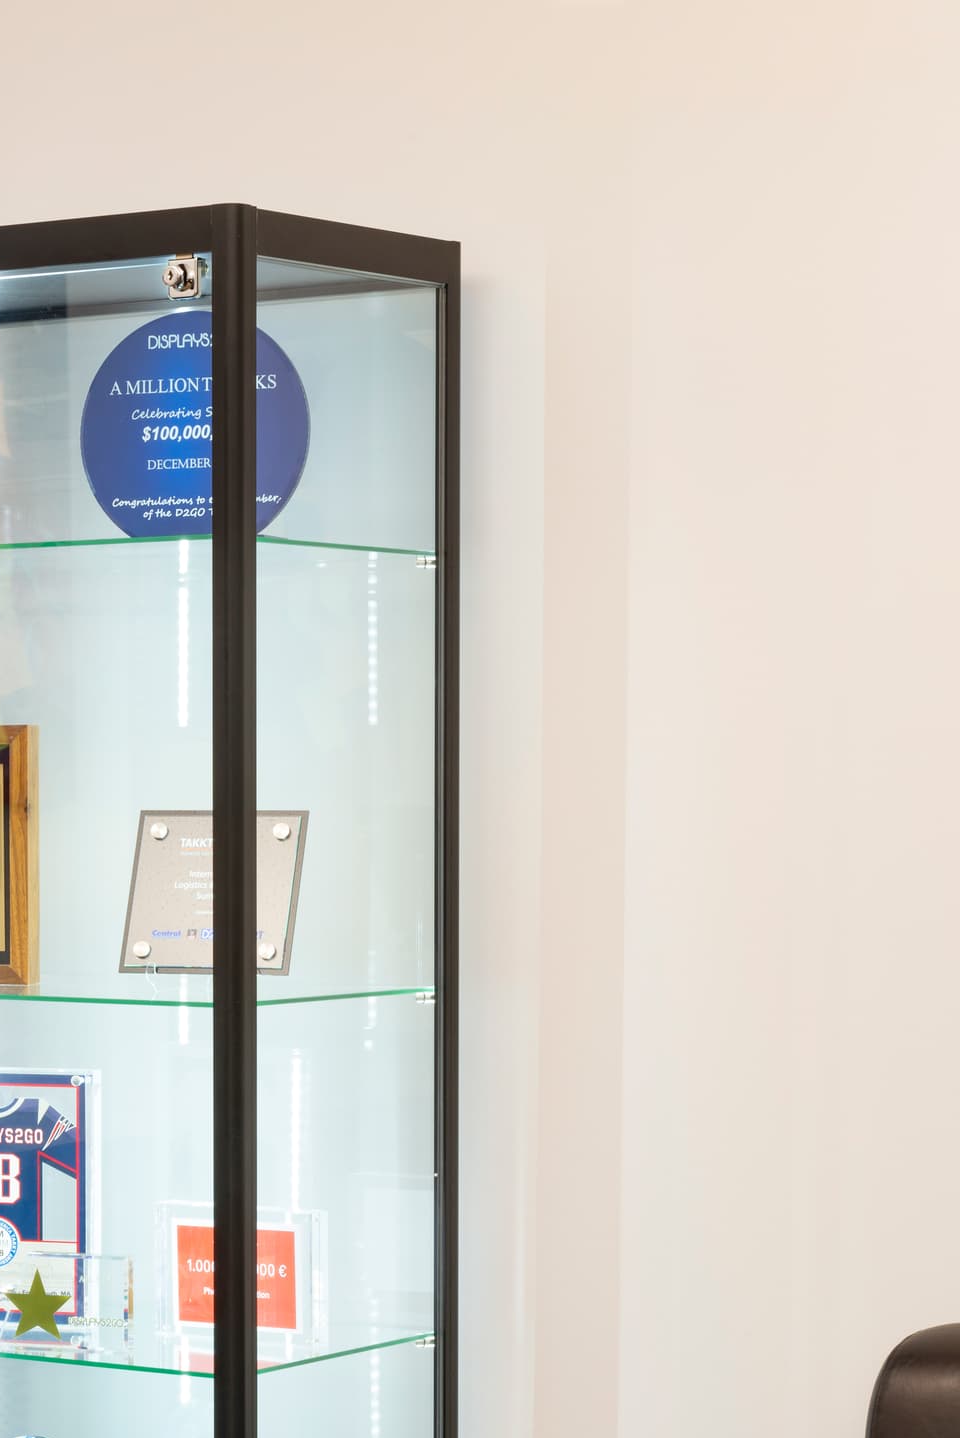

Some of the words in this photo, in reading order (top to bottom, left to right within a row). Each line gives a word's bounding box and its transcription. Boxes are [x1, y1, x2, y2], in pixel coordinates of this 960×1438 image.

[147, 333, 213, 350] DISPLAYS
[110, 381, 122, 396] A
[126, 377, 200, 395] MILLION
[131, 406, 202, 421] Celebrating
[147, 457, 212, 471] DECEMBER
[112, 495, 194, 509] Congratulations
[196, 495, 206, 505] to
[143, 509, 152, 520] of
[155, 508, 173, 518] the
[175, 508, 206, 518] D2GO
